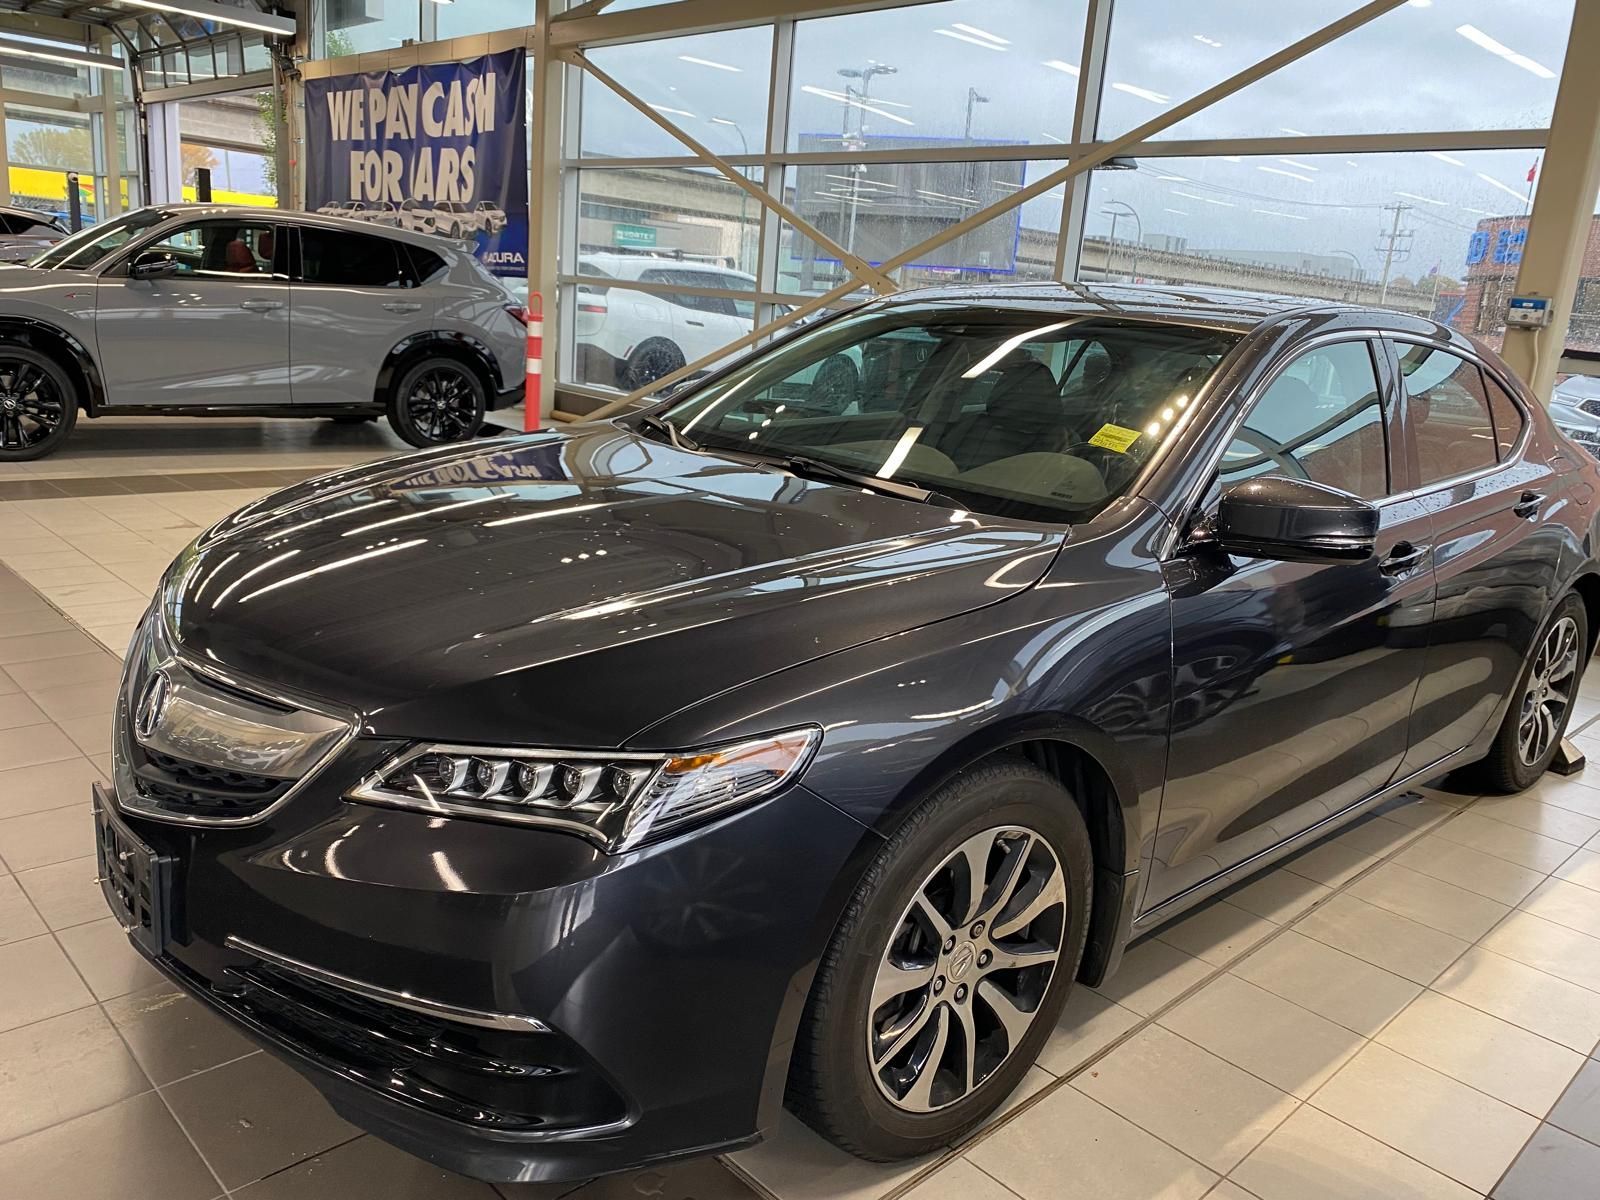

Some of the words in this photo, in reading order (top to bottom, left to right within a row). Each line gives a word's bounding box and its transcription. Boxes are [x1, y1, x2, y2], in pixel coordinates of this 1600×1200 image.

[327, 89, 365, 141] WE
[368, 83, 419, 140] PAY
[421, 73, 497, 138] CASH
[350, 150, 404, 202] FOR
